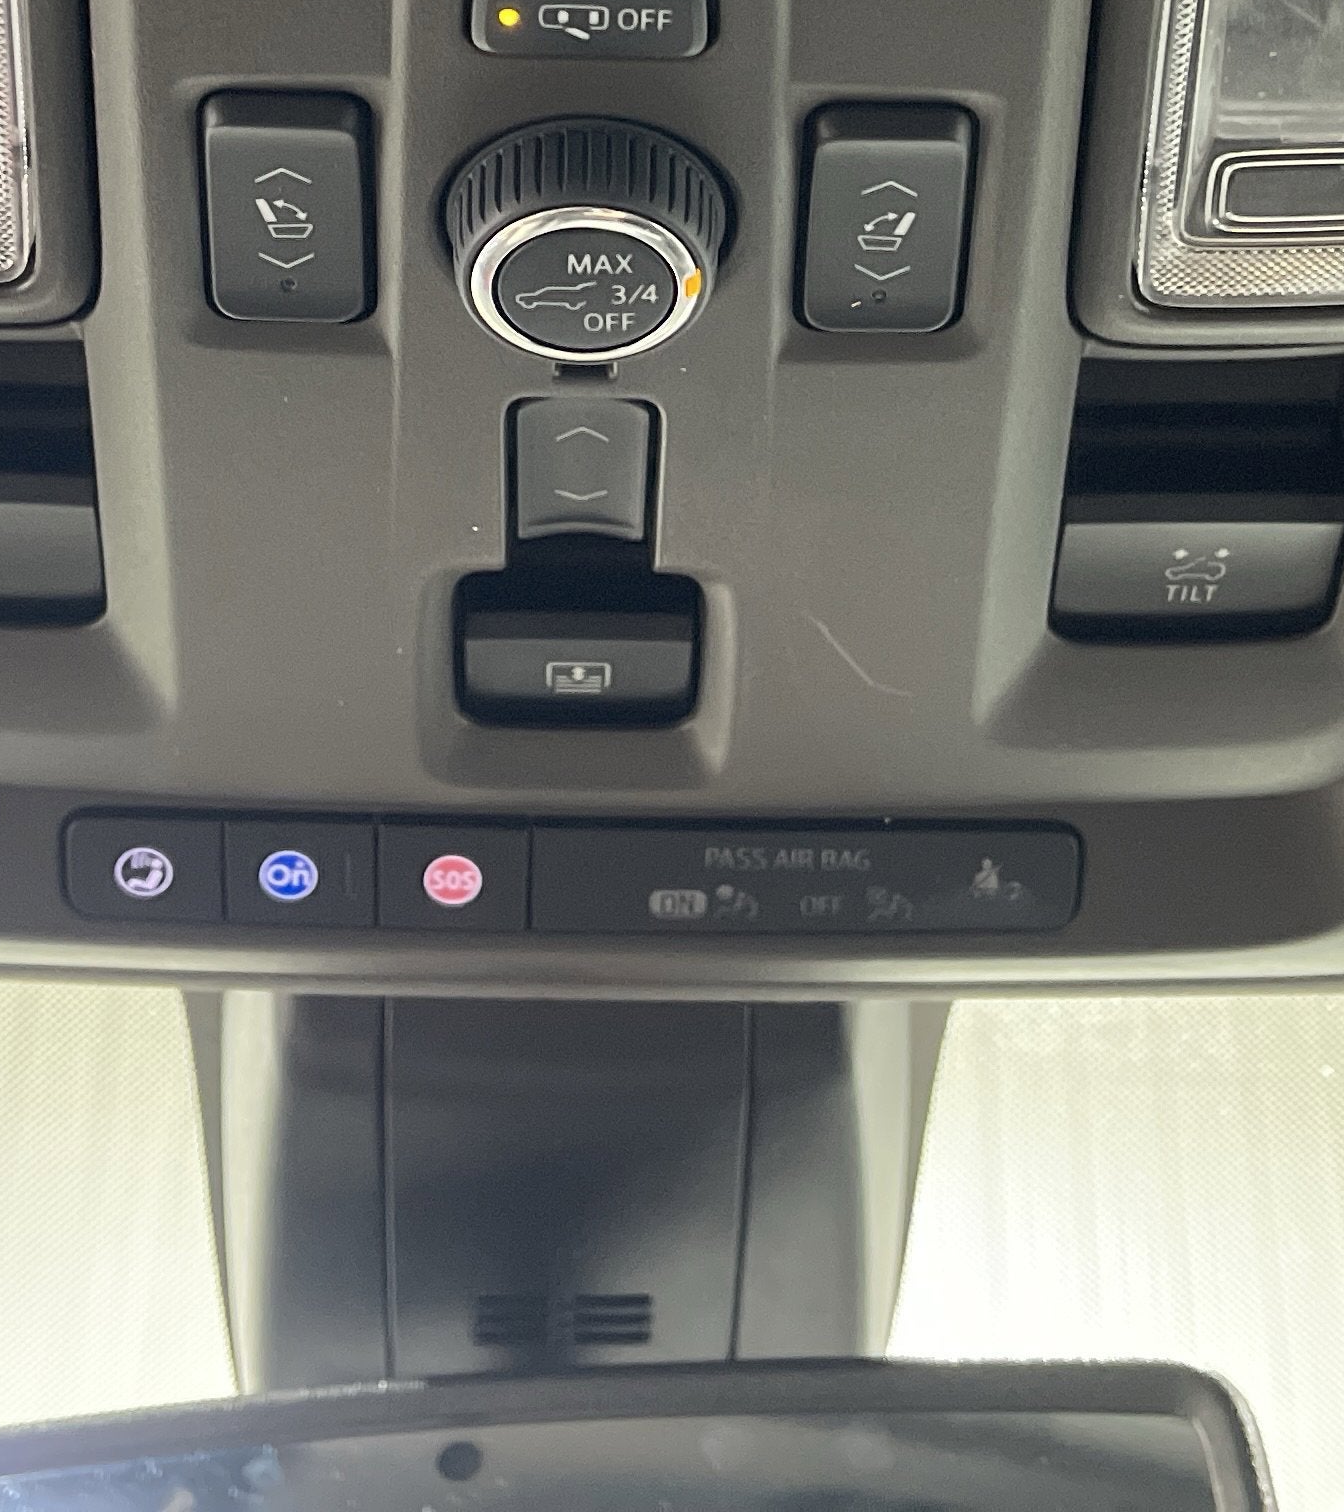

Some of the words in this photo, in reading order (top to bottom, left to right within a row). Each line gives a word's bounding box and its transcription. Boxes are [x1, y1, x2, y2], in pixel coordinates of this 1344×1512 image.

[617, 8, 673, 32] OFF
[567, 254, 633, 276] MAX
[610, 285, 658, 305] 3/4
[583, 313, 636, 332] OFF
[1166, 584, 1219, 603] TILT
[705, 847, 767, 870] PASS
[772, 848, 815, 871] AIR
[821, 848, 871, 871] BAG
[431, 868, 477, 890] SOS
